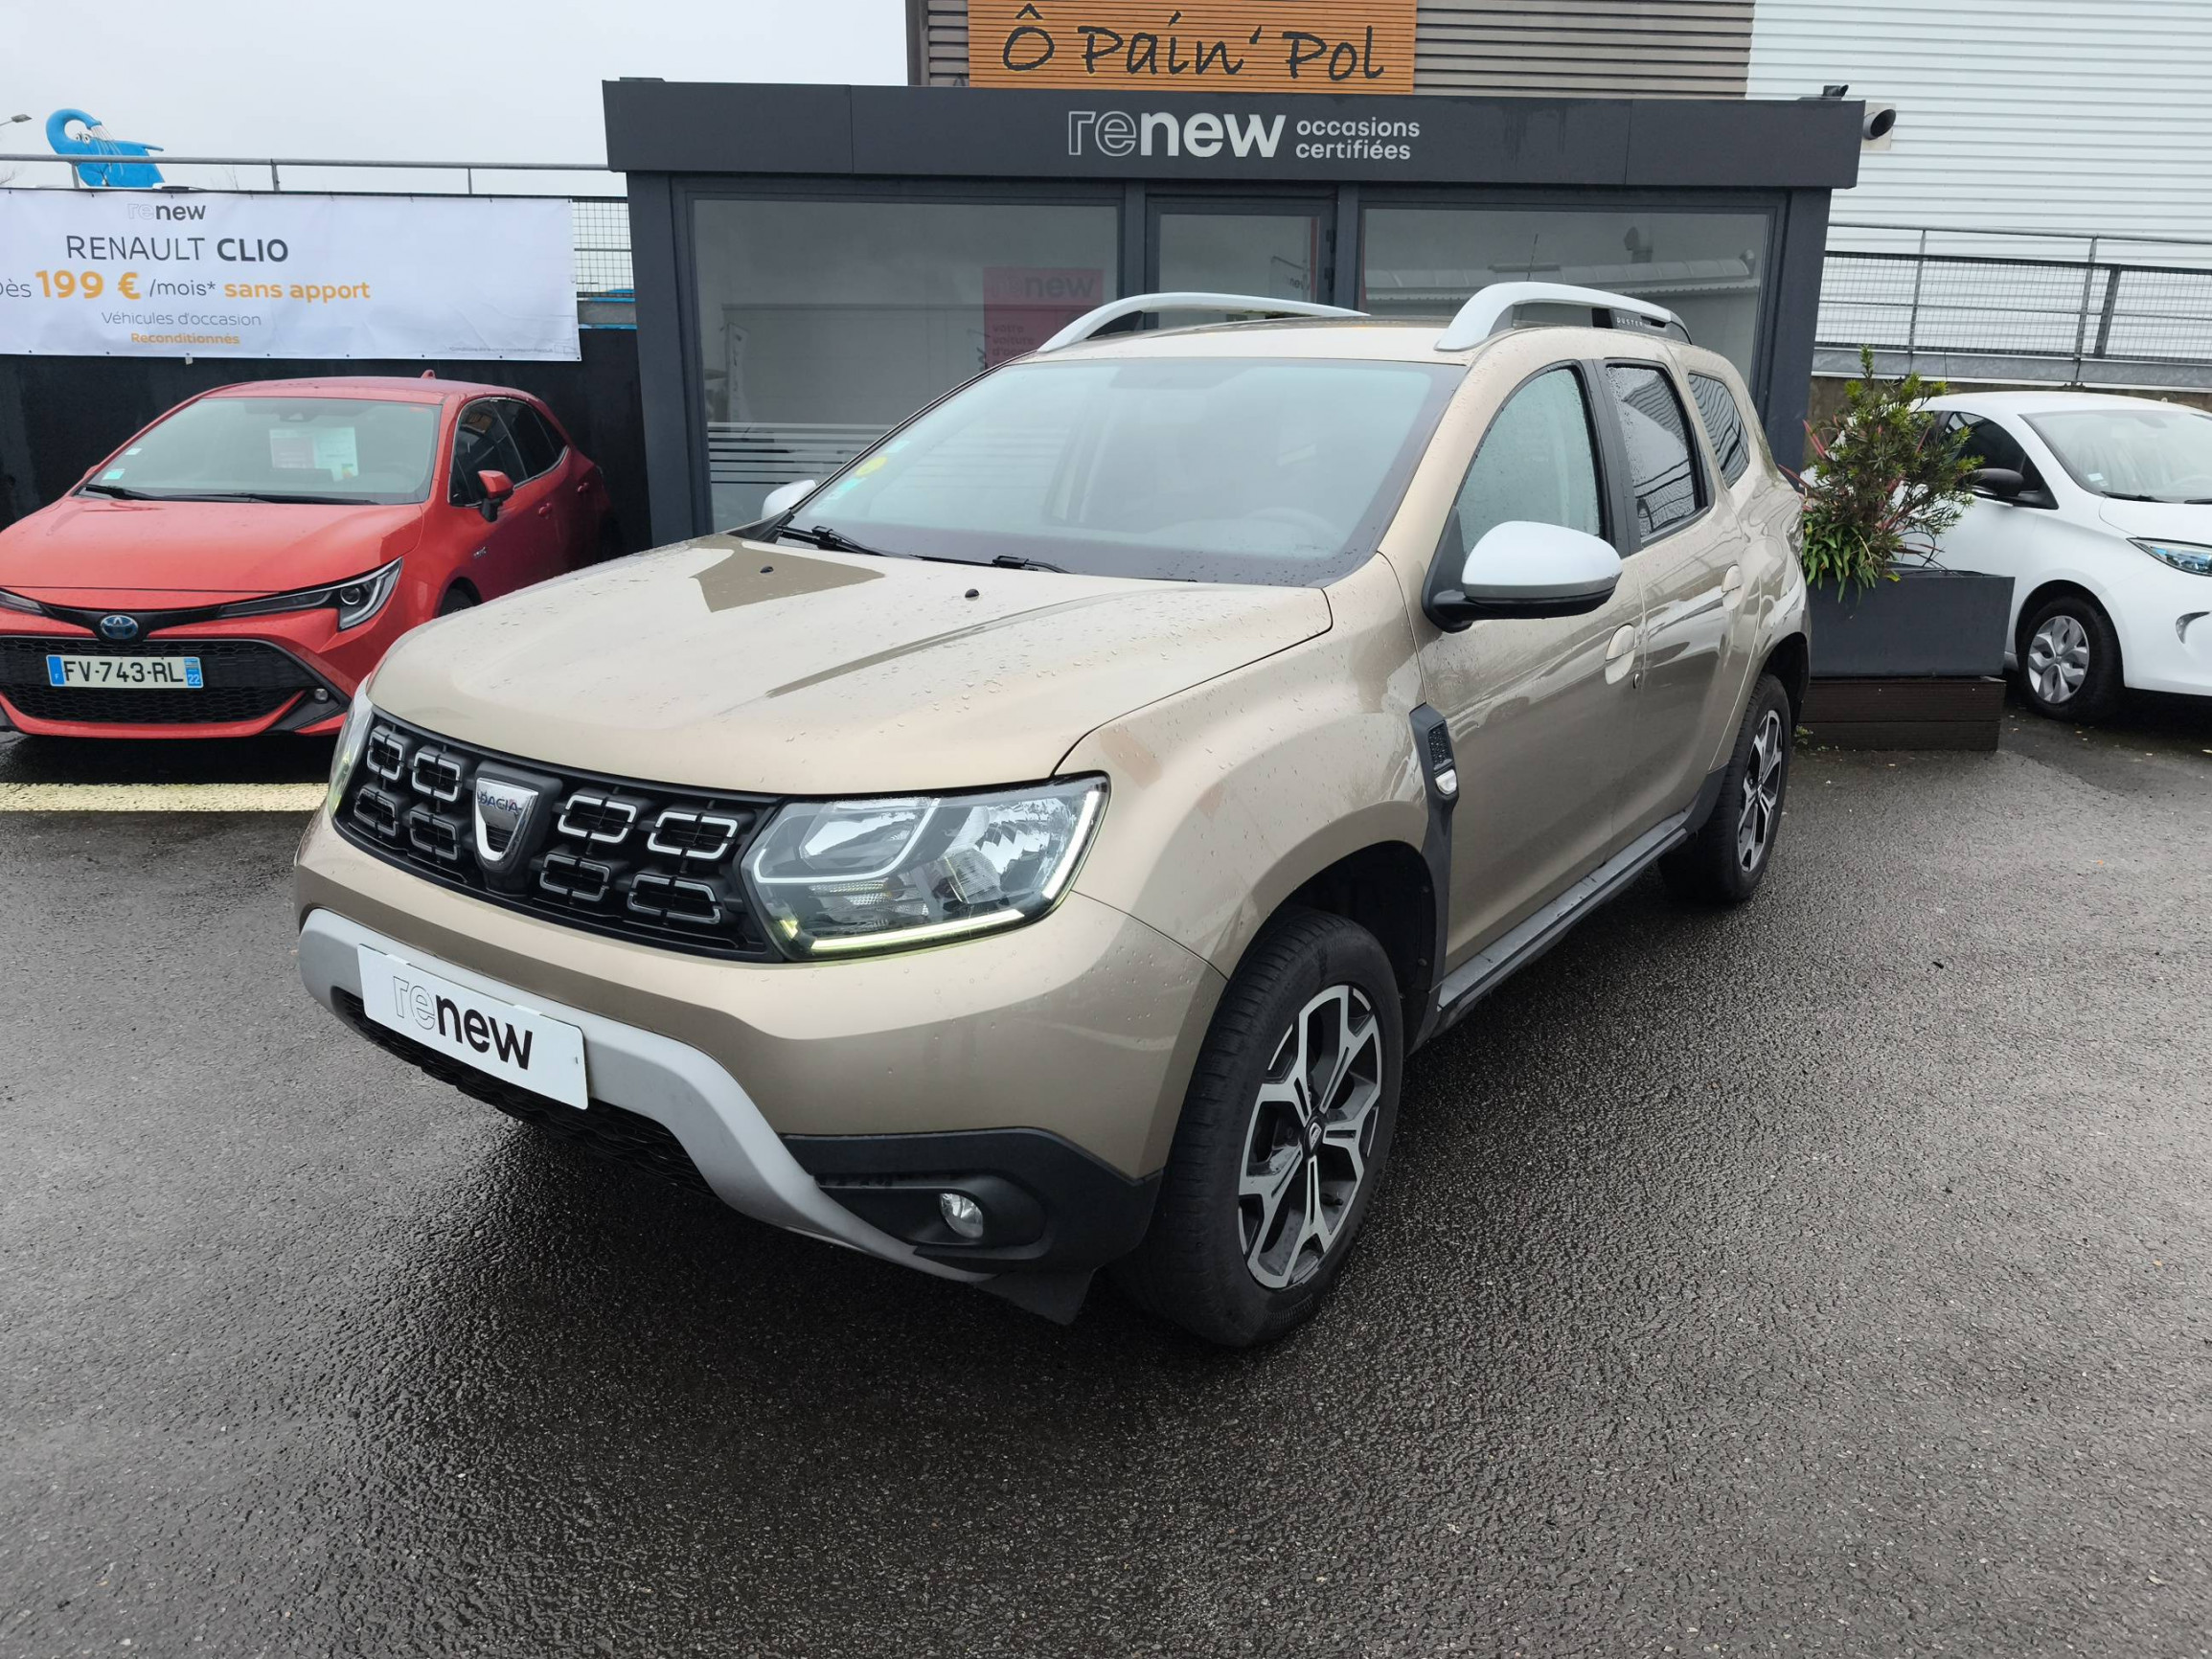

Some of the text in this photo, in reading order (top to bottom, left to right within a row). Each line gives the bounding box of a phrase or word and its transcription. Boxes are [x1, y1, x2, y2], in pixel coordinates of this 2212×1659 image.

[1002, 3, 1055, 72] Ô
[1282, 25, 1384, 81] Pol
[1068, 110, 1287, 158] renew
[1296, 117, 1421, 137] occasions
[1295, 139, 1411, 160] certifiées
[127, 202, 206, 221] renew
[66, 235, 288, 263] RENAULT CLIO
[0, 278, 32, 298] ès
[35, 269, 104, 300] 199
[118, 272, 141, 301] €
[224, 283, 284, 299] sans
[289, 282, 371, 304] apport
[102, 311, 262, 327] Véhicules d'occasion
[130, 332, 239, 345] Reconditionnés
[63, 660, 184, 683] FV-743-RL
[187, 673, 200, 685] 22
[393, 975, 534, 1071] renew
